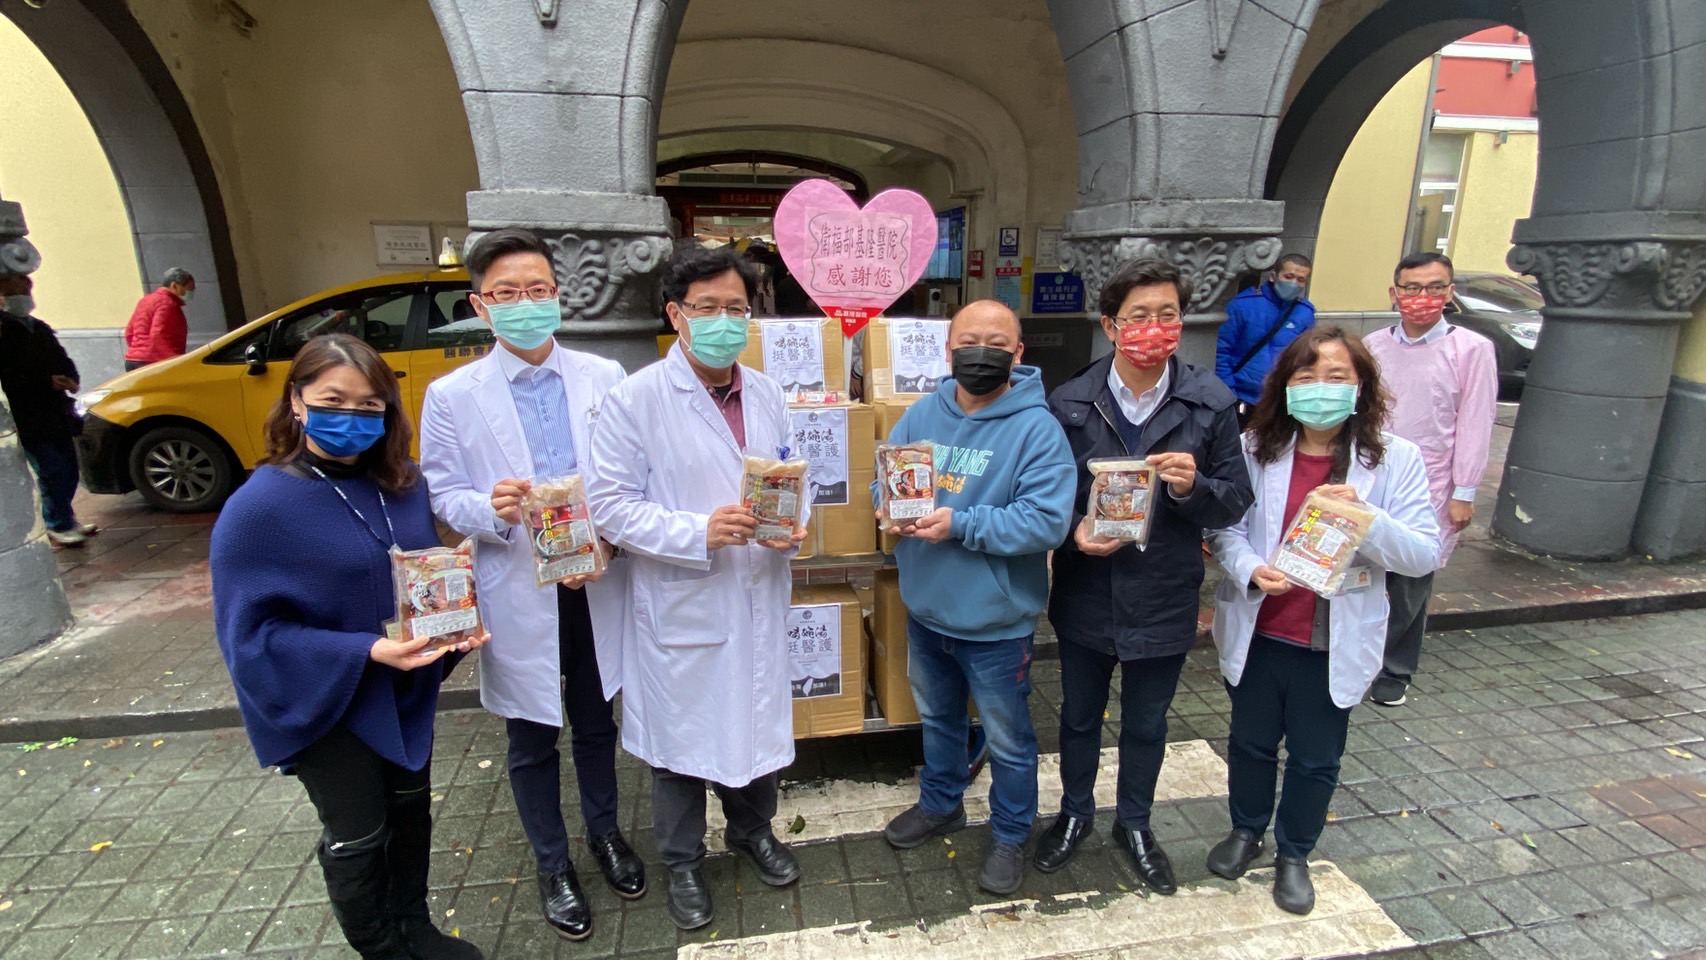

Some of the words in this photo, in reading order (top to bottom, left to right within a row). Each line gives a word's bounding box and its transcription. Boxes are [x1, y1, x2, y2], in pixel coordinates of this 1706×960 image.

[820, 222, 898, 260] 衛福部基隆醫院
[827, 264, 893, 288] 感謝您
[772, 348, 816, 361] 挺醫護
[900, 345, 942, 357] 挺醫護
[947, 446, 994, 477] YANG
[787, 625, 828, 640] 喝碗湯
